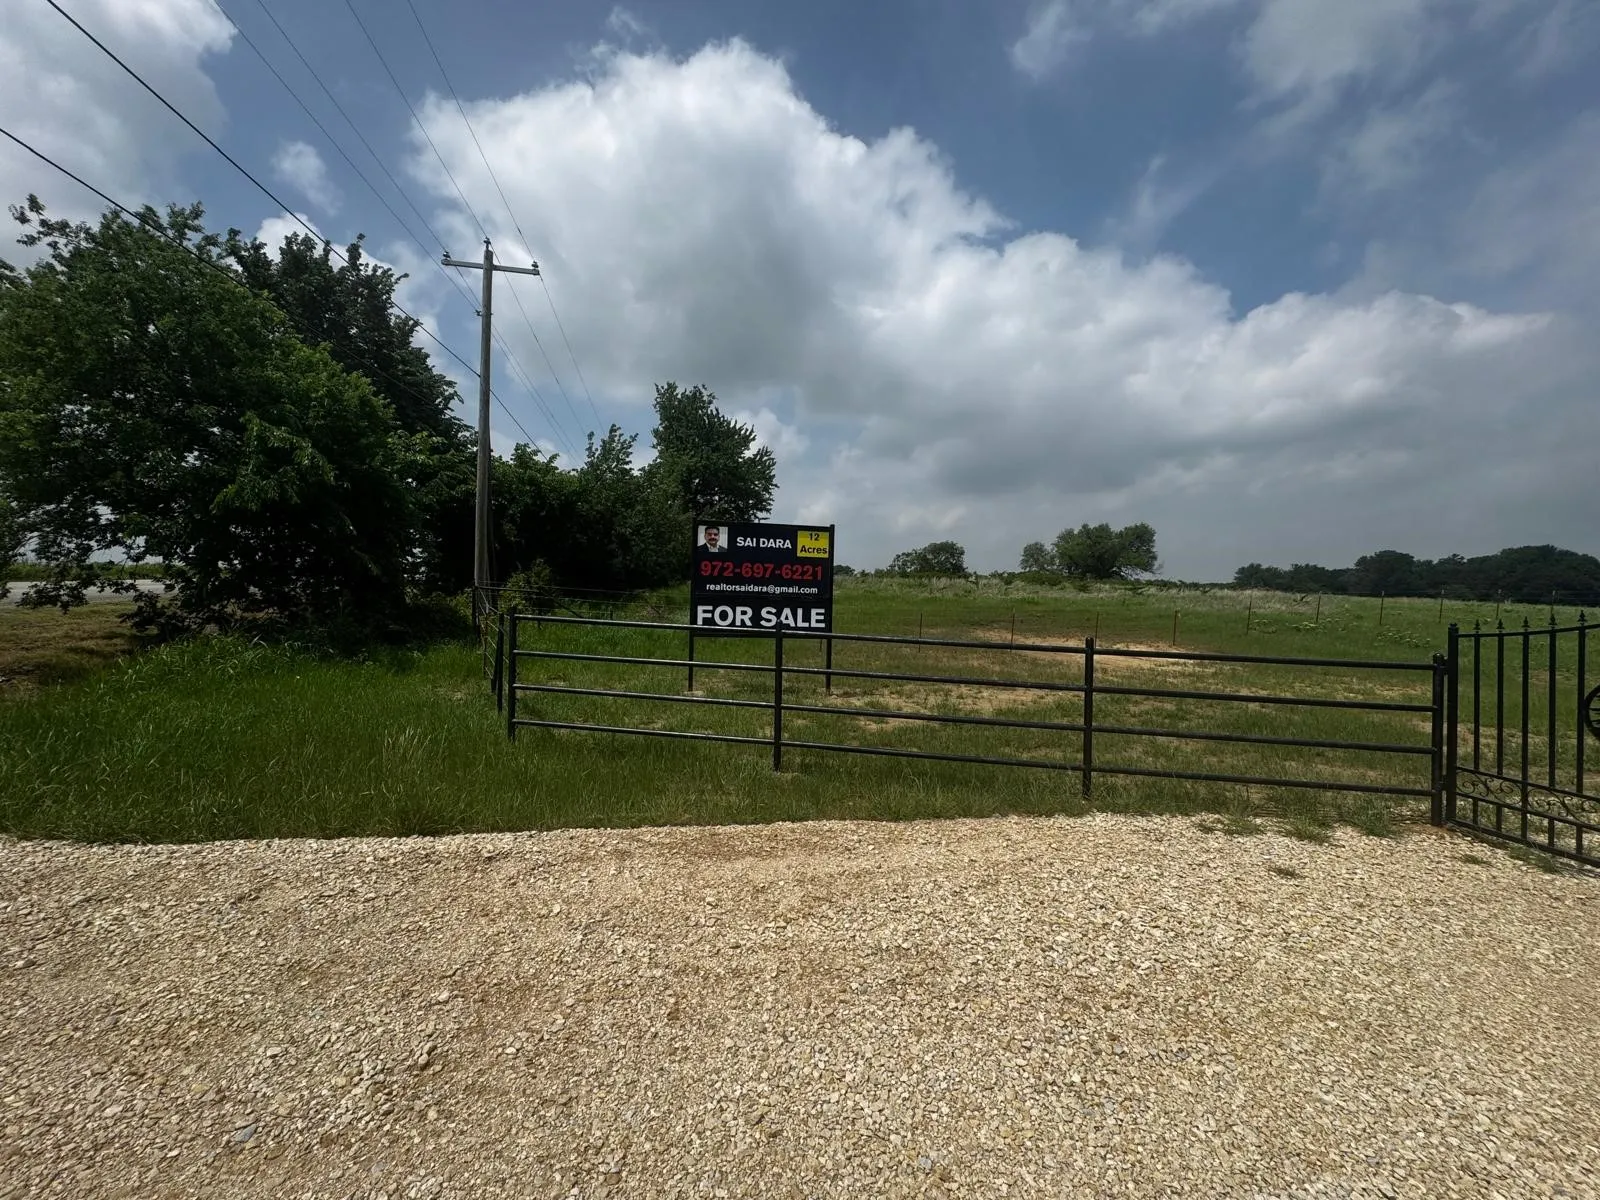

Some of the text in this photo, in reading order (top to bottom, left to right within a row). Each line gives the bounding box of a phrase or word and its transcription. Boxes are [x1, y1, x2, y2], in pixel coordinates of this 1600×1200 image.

[736, 536, 792, 549] SAI DARA
[808, 532, 820, 541] 12
[799, 545, 828, 554] Acres
[700, 560, 823, 580] 972-697-6221
[706, 583, 818, 594] realtorsaidara@gmail.com
[696, 605, 826, 628] FOR SALE
